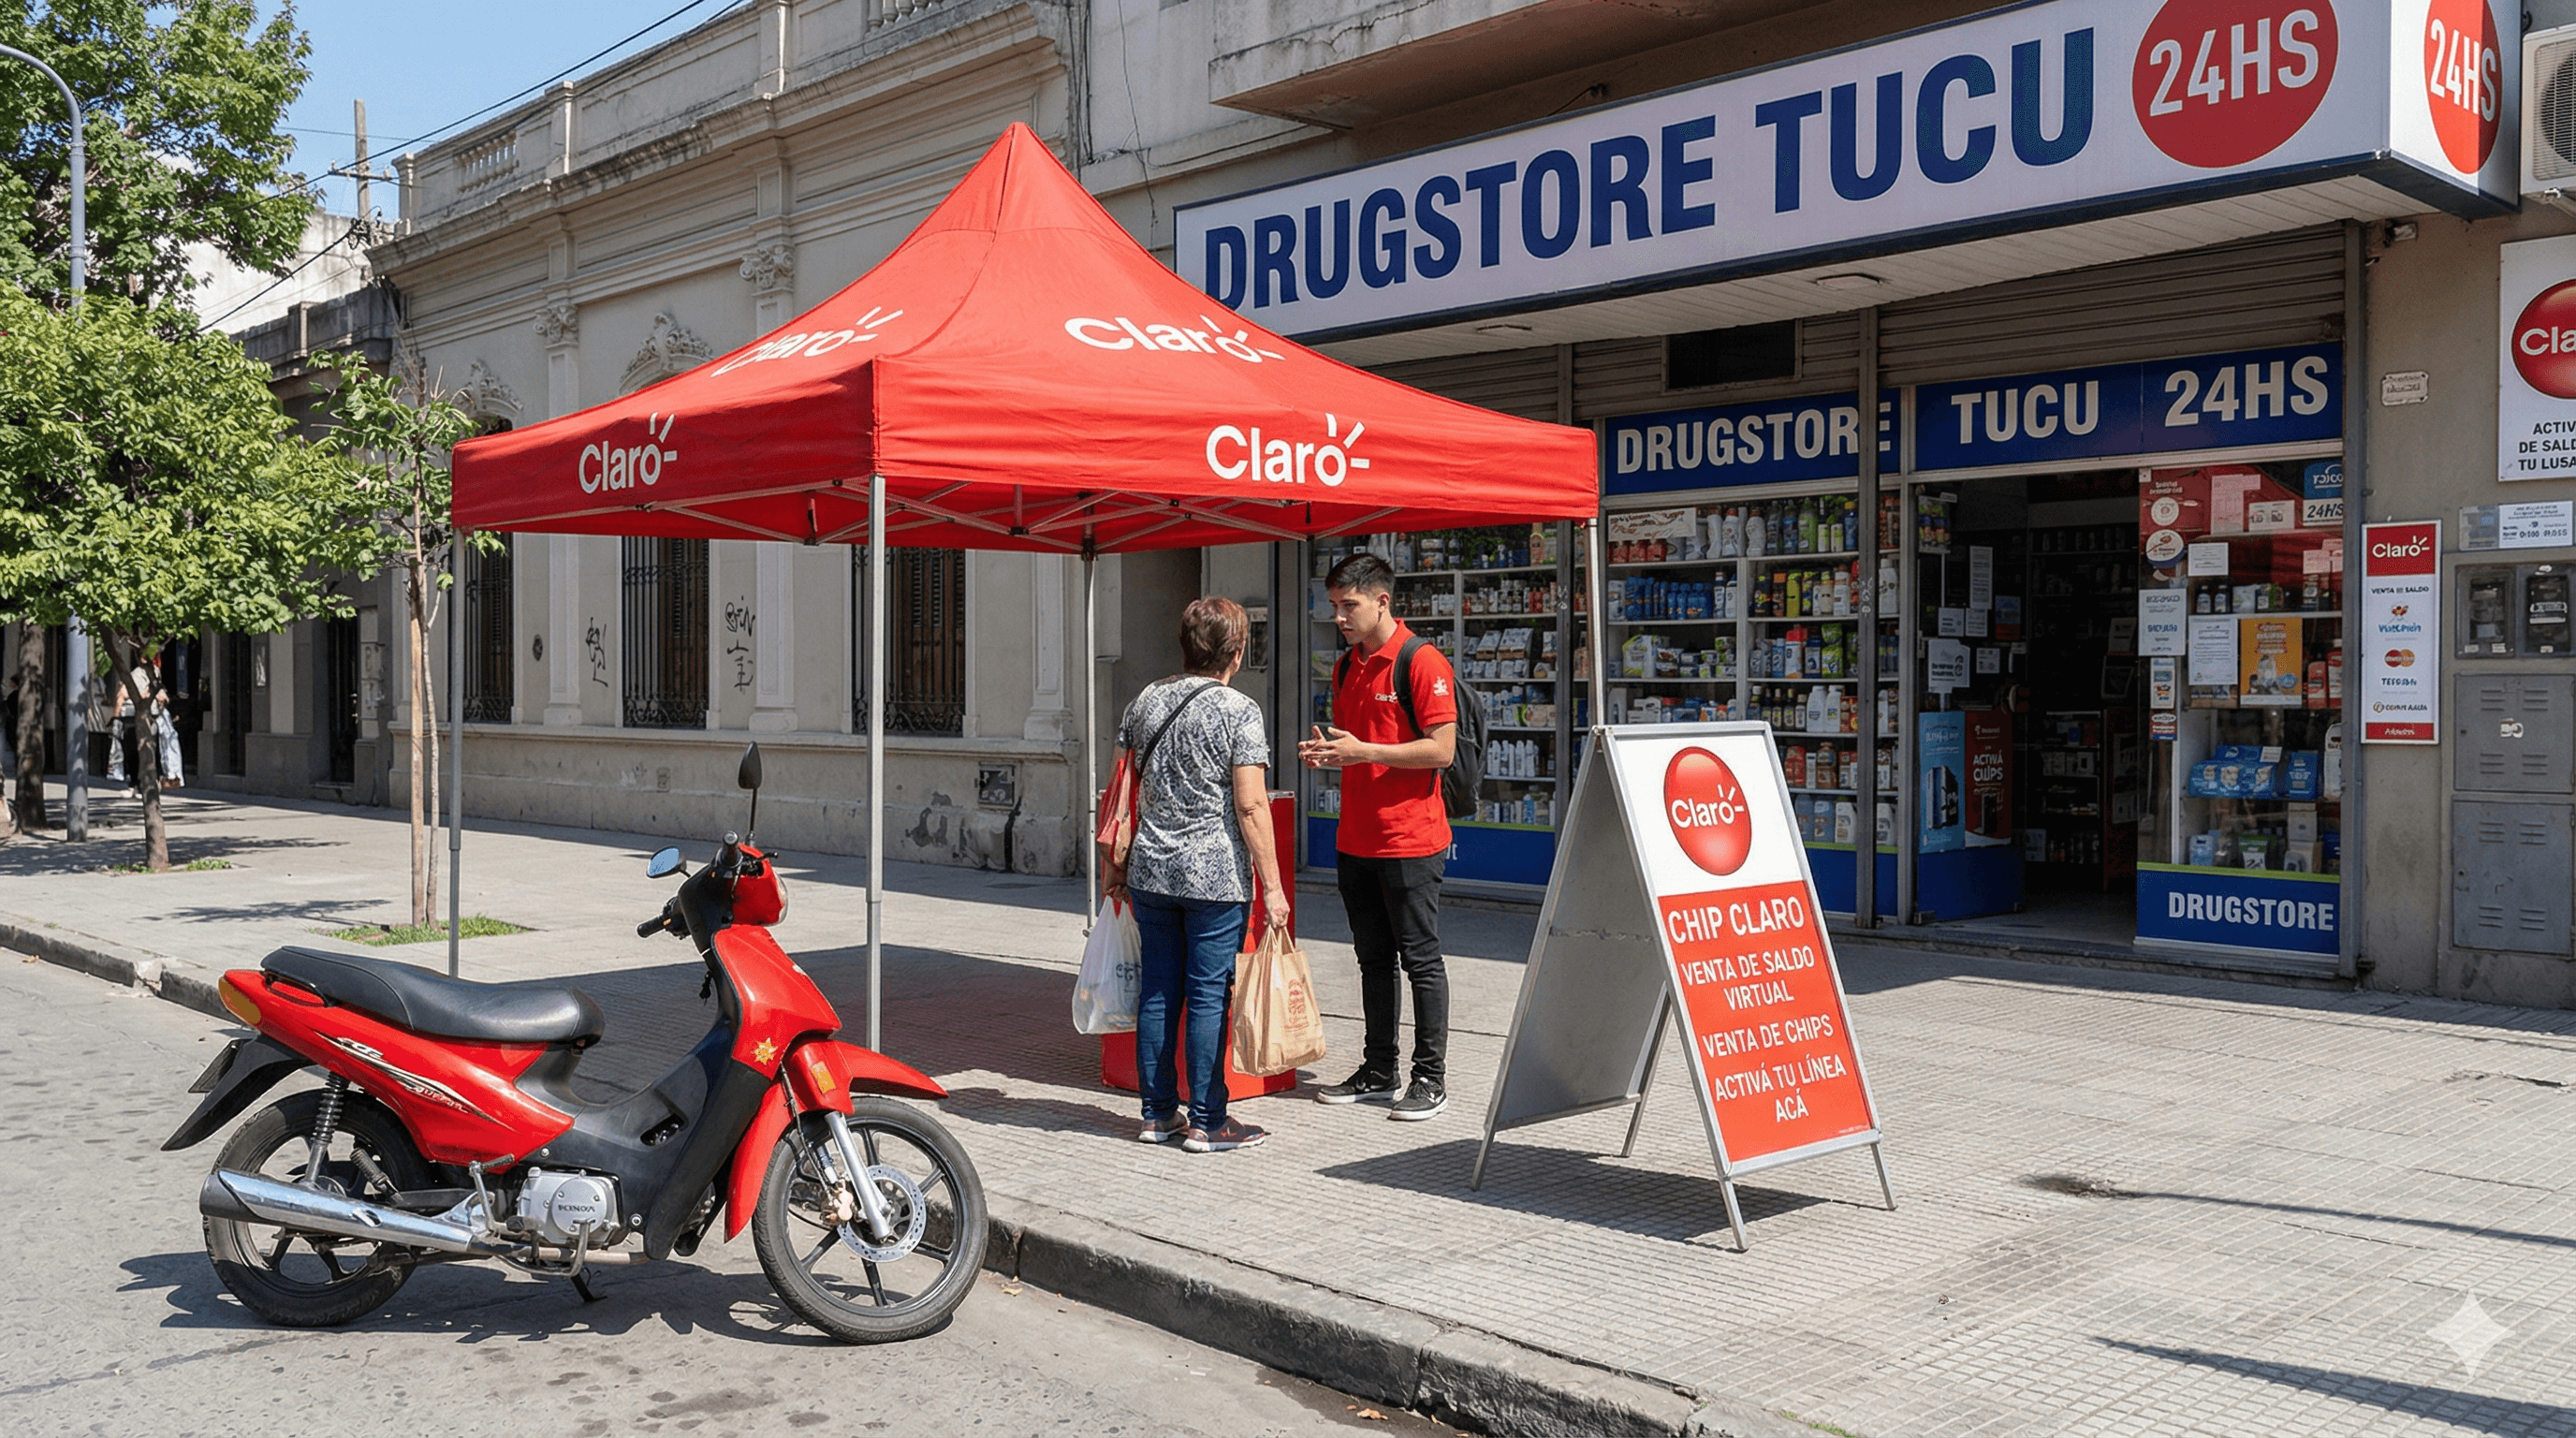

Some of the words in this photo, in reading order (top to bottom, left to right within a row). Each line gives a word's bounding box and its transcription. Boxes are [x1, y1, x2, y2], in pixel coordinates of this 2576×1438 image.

[2429, 18, 2497, 122] 24HS
[1205, 115, 1716, 312] DRUGSTORE
[1755, 26, 2095, 214] TUCU
[2148, 8, 2320, 117] 24HS
[710, 324, 871, 377] Claro
[1064, 316, 1268, 363] Claro
[1951, 380, 2100, 444] TUCU
[2163, 356, 2329, 427] 24HS
[578, 431, 667, 494] Claro
[1206, 420, 1354, 487] Claro
[2519, 441, 2538, 453] DE
[2519, 458, 2537, 470] TU
[2372, 539, 2424, 559] Claro
[1672, 793, 1738, 829] Claro
[1668, 906, 1723, 944] CHIP
[1729, 896, 1805, 936] CLARO
[2168, 891, 2334, 932] DRUGSTORE
[1681, 957, 1737, 986] VENTA
[1737, 953, 1762, 978] DE
[1763, 946, 1815, 974] SALDO
[1723, 979, 1794, 1010] VIRTUAL
[1702, 1027, 1759, 1058] VENTA
[1759, 1022, 1784, 1049] DE
[1785, 1014, 1834, 1044] CHIPS
[1715, 1062, 1774, 1102] ACTIVÁ
[1772, 1064, 1796, 1089] TU
[1797, 1053, 1847, 1084] LÍNEA
[1776, 1088, 1809, 1123] ACÁ
